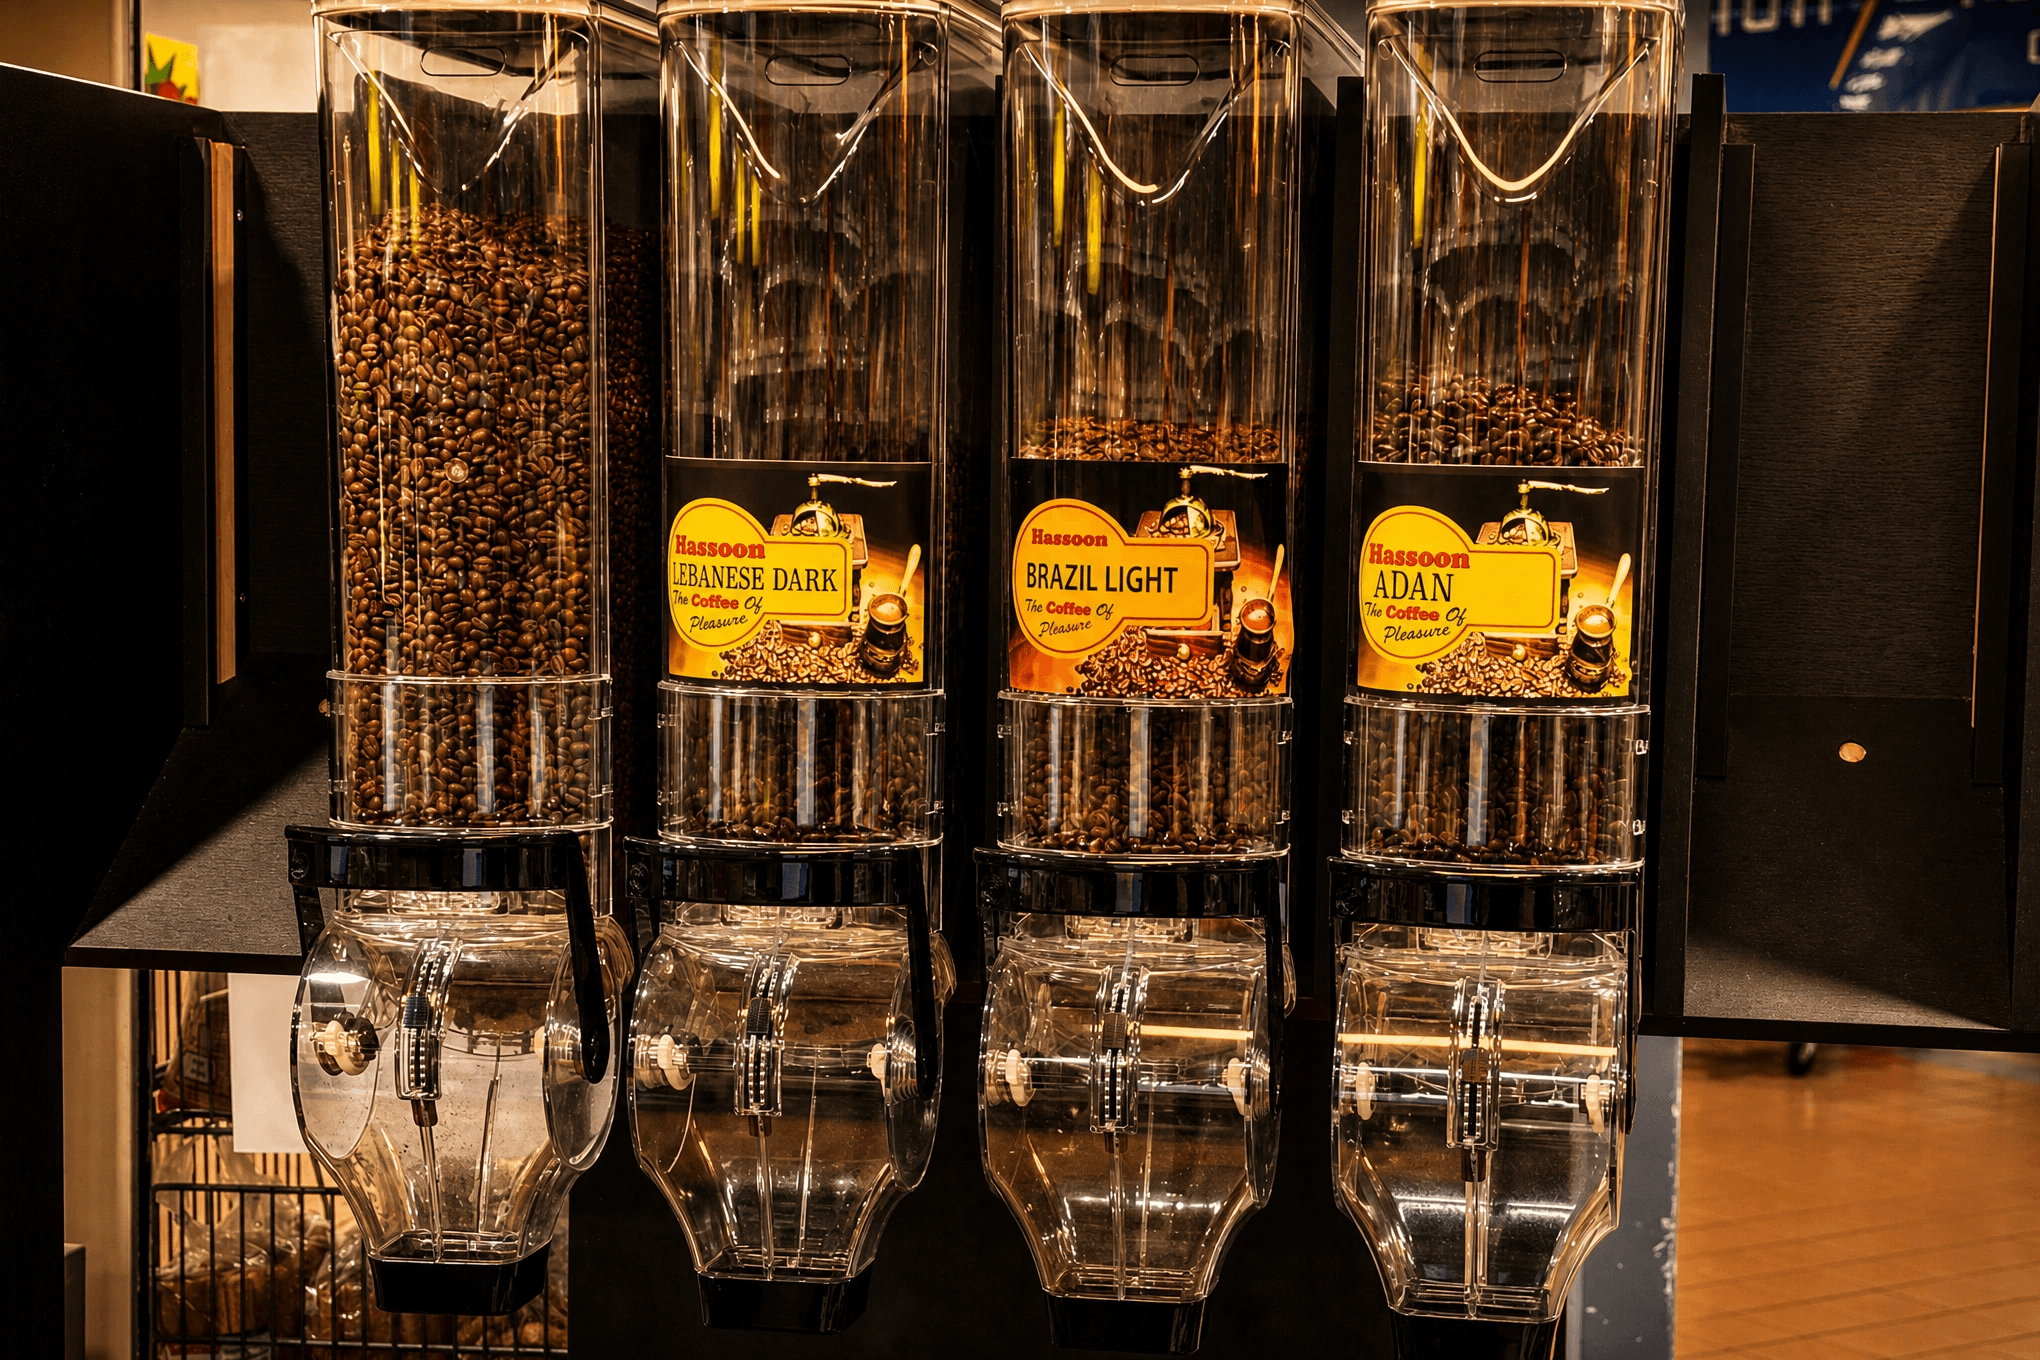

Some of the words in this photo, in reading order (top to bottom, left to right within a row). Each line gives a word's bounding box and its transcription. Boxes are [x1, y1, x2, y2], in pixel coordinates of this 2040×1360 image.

[675, 534, 765, 559] Hassoon
[1032, 528, 1108, 546] Hassoon
[1369, 543, 1470, 568] Hassoon
[673, 562, 764, 590] LEBANESE
[773, 568, 838, 592] DARK
[1027, 562, 1098, 591] BRAZIL
[1105, 566, 1178, 593] LIGHT
[1374, 570, 1454, 602] ADAN
[673, 590, 688, 605] The
[691, 593, 739, 609] Coffee
[744, 597, 763, 614] Of
[1025, 599, 1042, 613] The
[1046, 601, 1091, 616] Coffee
[1096, 604, 1114, 620] Of
[1364, 602, 1382, 618] The
[1386, 605, 1440, 621] Coffee
[1446, 607, 1467, 626] Of
[690, 614, 748, 633] Pleasure
[1038, 620, 1092, 637] Pleasure
[1384, 625, 1450, 643] Pleasure
